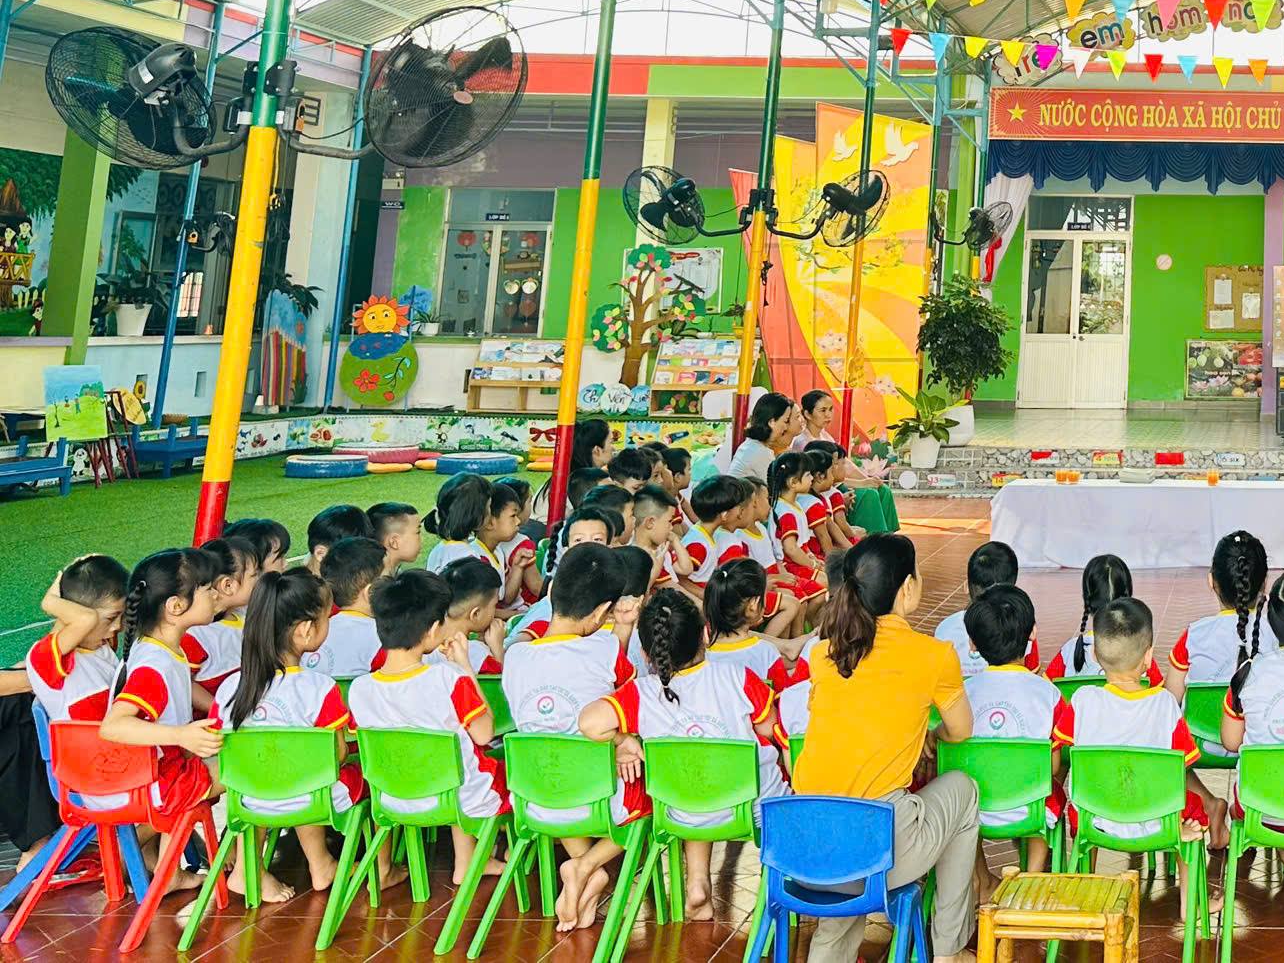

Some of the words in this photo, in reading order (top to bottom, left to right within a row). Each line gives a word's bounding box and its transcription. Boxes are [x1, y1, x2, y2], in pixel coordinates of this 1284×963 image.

[1080, 23, 1125, 49] em
[1039, 98, 1086, 127] NƯỚC
[1090, 99, 1139, 132] CỘNG
[1142, 99, 1179, 128] HÒA
[1182, 101, 1204, 128] XÃ
[1211, 100, 1242, 133] HỘI
[1246, 101, 1281, 129] CHỦ
